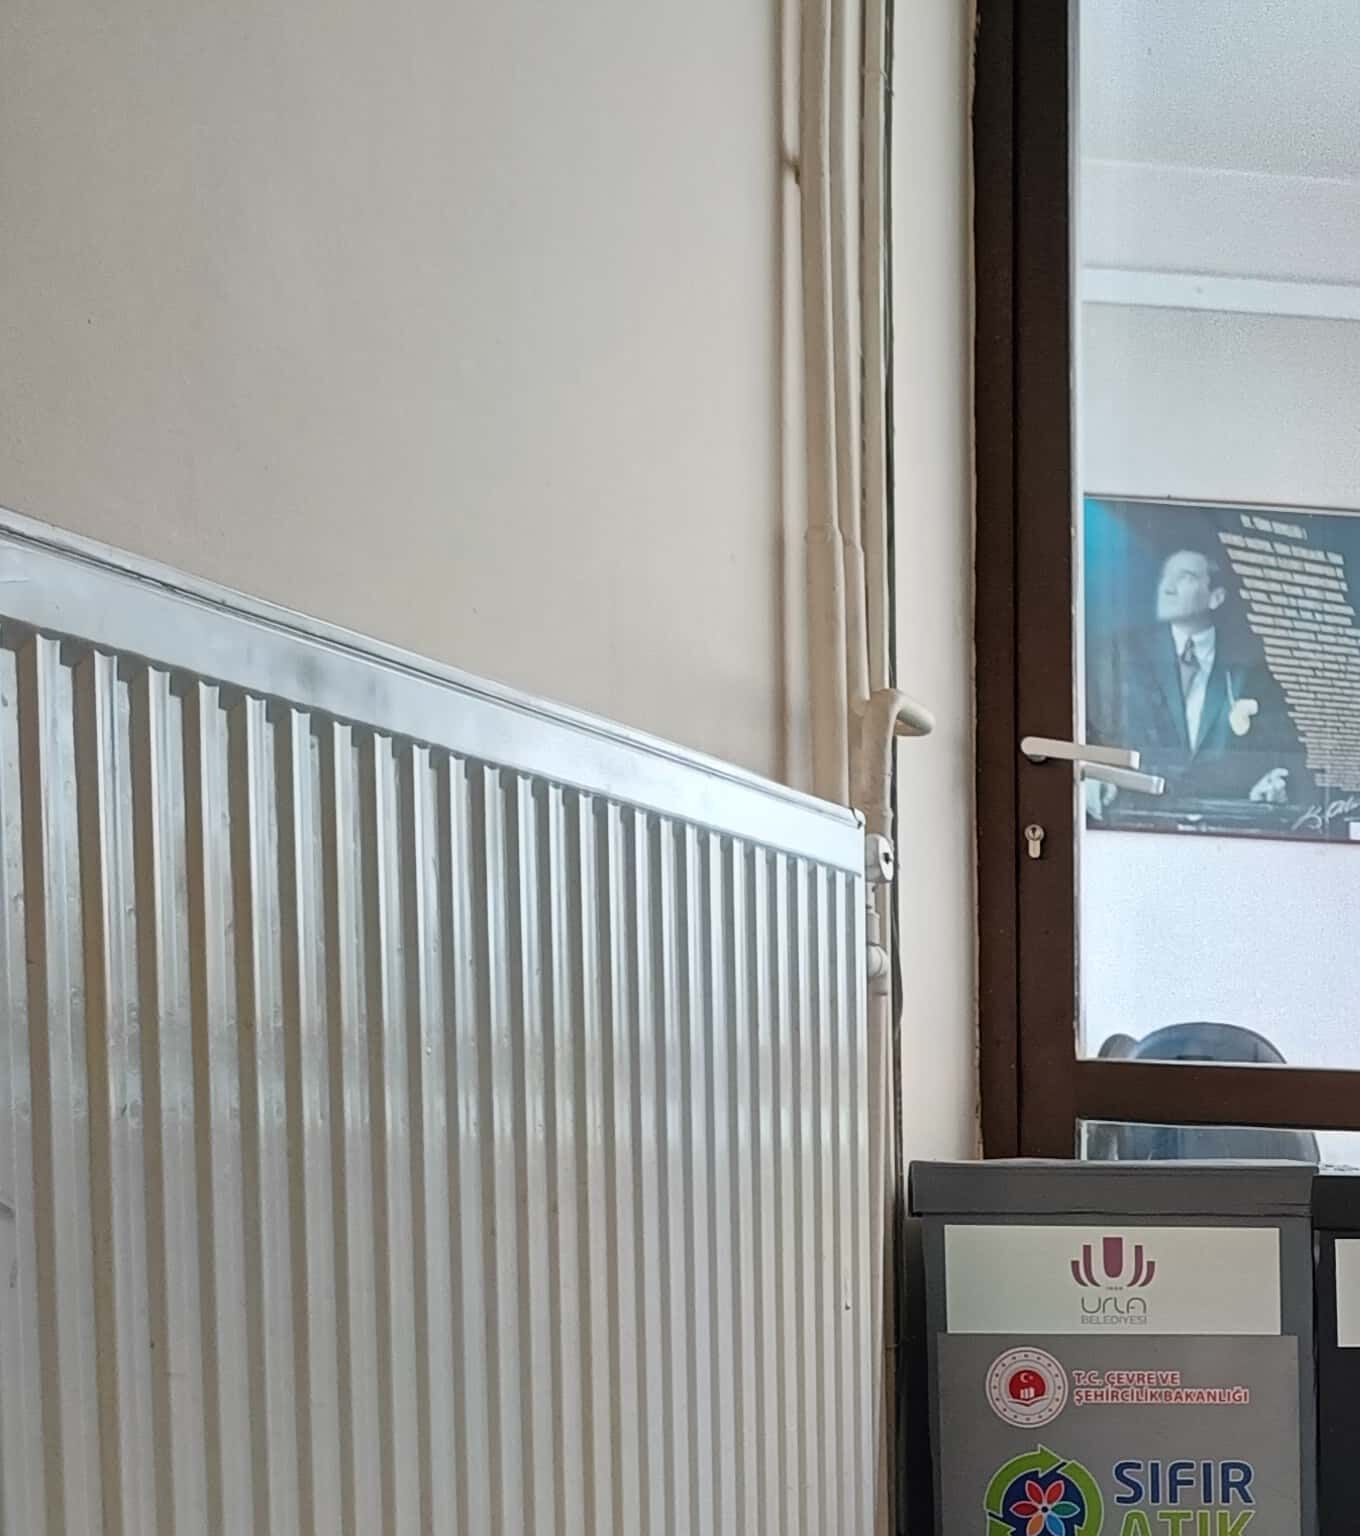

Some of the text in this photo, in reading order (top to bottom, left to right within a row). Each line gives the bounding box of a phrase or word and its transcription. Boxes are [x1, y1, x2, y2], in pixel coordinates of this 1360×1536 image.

[1073, 1371, 1180, 1388] T.C. ÇEVRE VE
[1074, 1386, 1249, 1406] ŞEHİRCİLİK BAKANLIĞI
[1112, 1460, 1255, 1505] SIFIR
